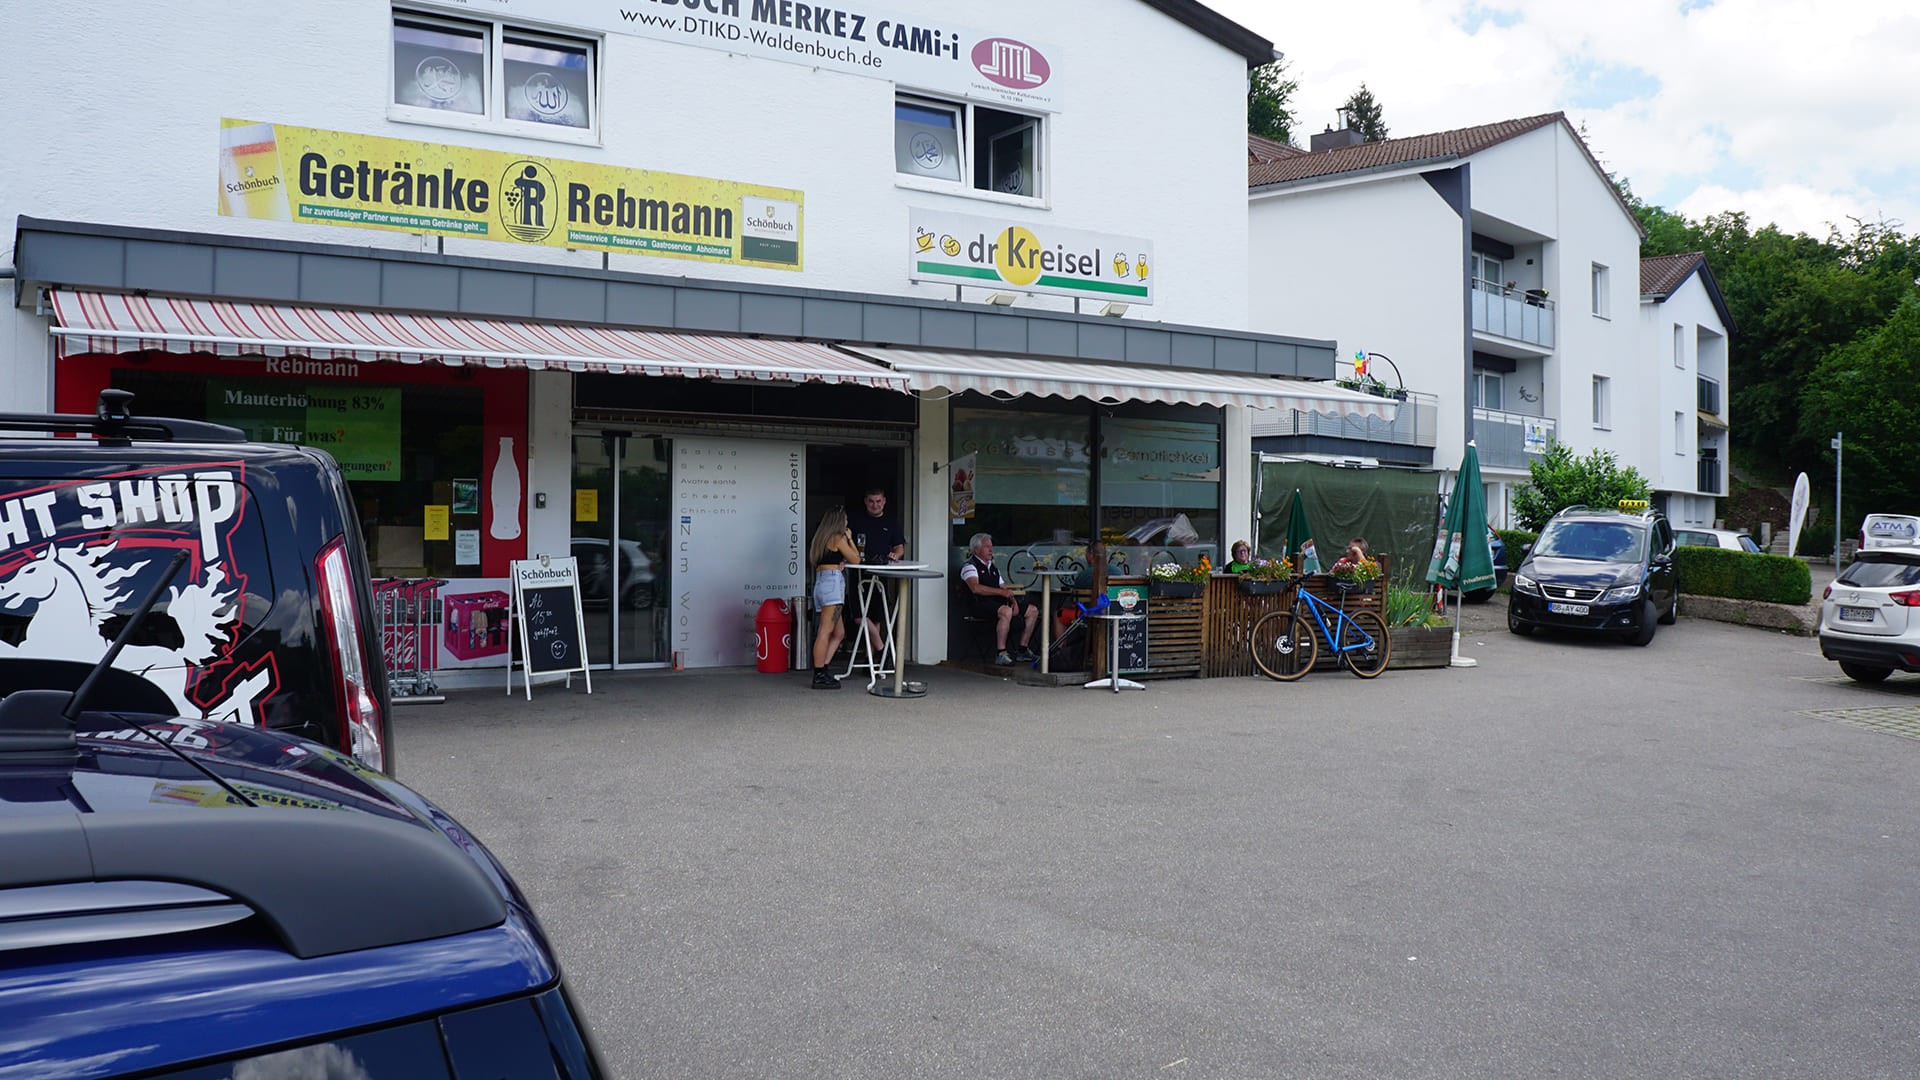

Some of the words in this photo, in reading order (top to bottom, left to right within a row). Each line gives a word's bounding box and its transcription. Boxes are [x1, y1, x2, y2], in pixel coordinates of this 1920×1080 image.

[751, 1, 867, 42] MERKEZ
[619, 9, 883, 68] www.DTIKD-Waldenbuch.de
[226, 174, 280, 194] Schönbuch
[299, 152, 489, 213] Getränke
[302, 205, 313, 215] Ihr
[313, 207, 362, 221] zuverlässiger
[363, 211, 389, 223] Partner
[390, 215, 409, 225] wenn
[409, 217, 419, 225] es
[419, 218, 431, 227] um
[432, 217, 463, 231] Getränke
[463, 221, 479, 232] geht
[567, 182, 733, 239] Rebmann
[746, 216, 793, 232] Schönbuch
[570, 231, 608, 244] Heimservice
[612, 235, 647, 248] Festservice
[651, 239, 692, 252] Gastroservice
[696, 244, 730, 256] Abholmarkt
[968, 233, 999, 264] dr
[265, 357, 359, 377] Rebmann
[224, 389, 347, 412] Mauterhöhung
[351, 396, 385, 411] 83%
[272, 426, 303, 442] Für
[307, 429, 345, 444] was?
[788, 452, 800, 515] Appetit
[76, 471, 237, 562] SHOP
[1872, 522, 1902, 530] ATM
[680, 524, 691, 573] Zum
[788, 522, 799, 576] Guten
[521, 567, 572, 580] Schönbuch
